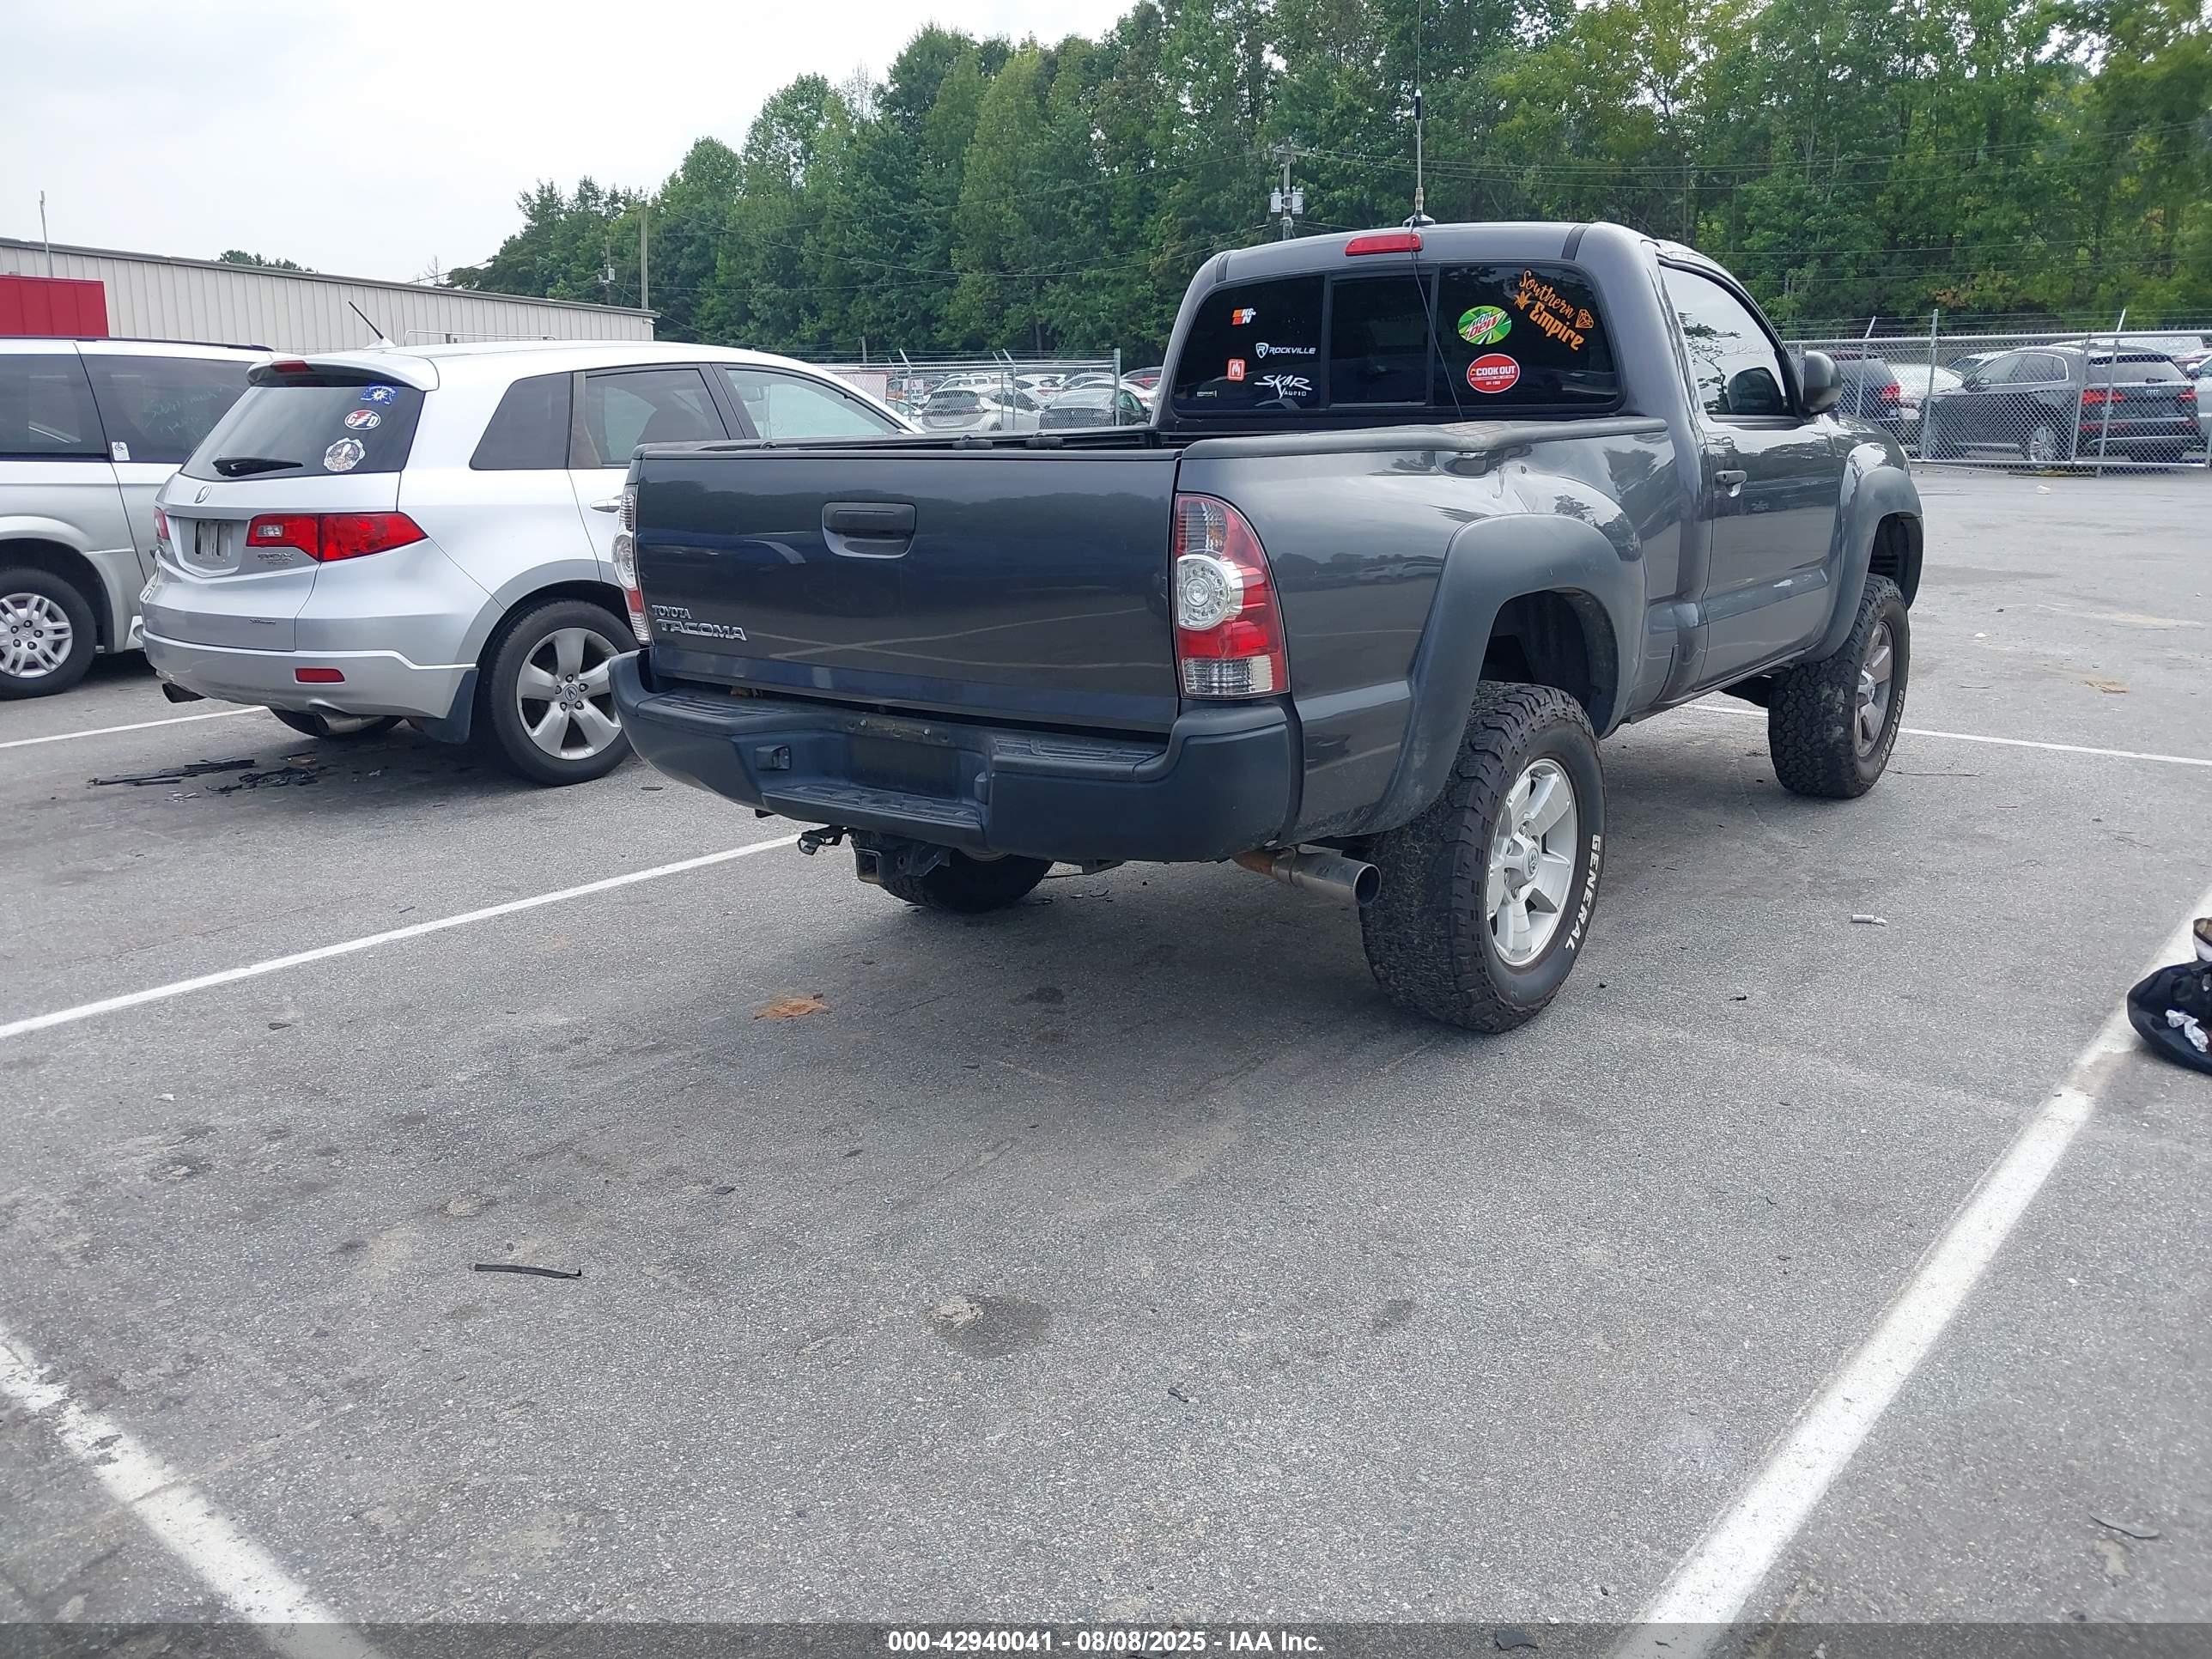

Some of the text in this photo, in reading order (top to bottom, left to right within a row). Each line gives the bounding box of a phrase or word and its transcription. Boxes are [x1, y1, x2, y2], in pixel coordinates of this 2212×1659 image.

[1518, 270, 1576, 319] Southern
[1528, 301, 1585, 350] Empire
[1268, 347, 1316, 356] ROCKVILLE
[1499, 365, 1516, 374] OUT
[651, 605, 692, 620] TOYOTA
[655, 618, 748, 641] TACOMA
[1565, 834, 1601, 951] GENERAL
